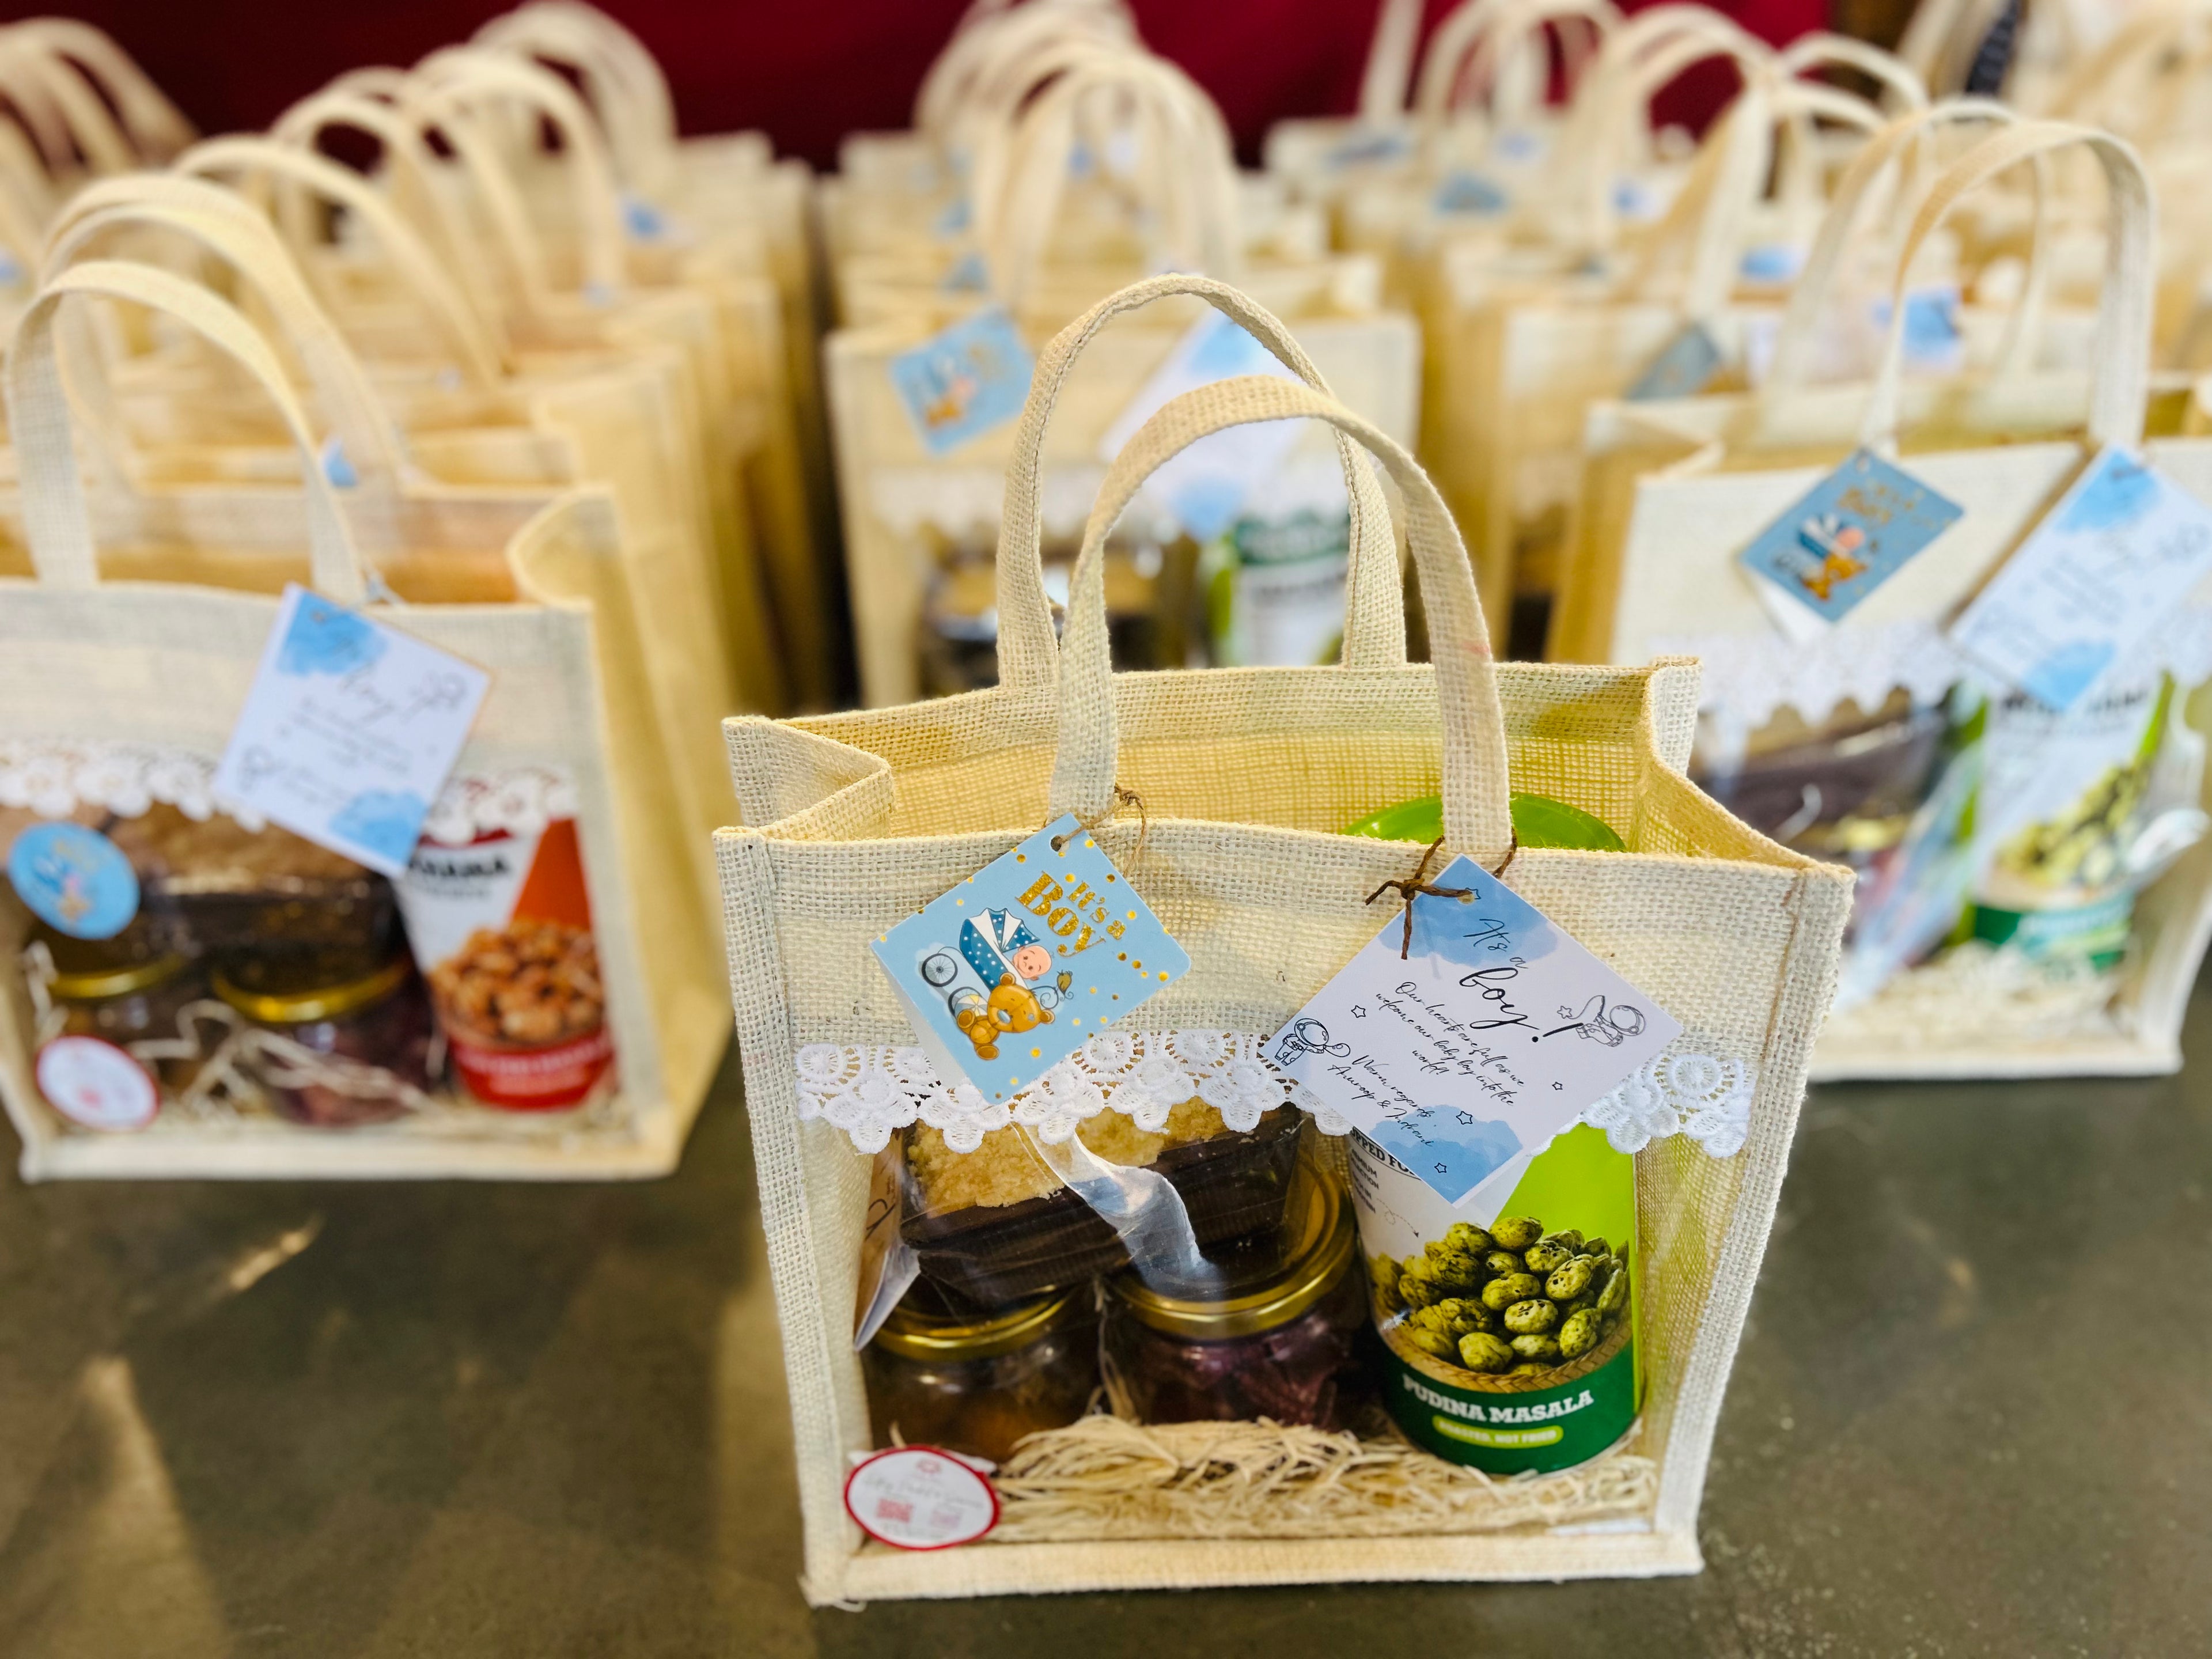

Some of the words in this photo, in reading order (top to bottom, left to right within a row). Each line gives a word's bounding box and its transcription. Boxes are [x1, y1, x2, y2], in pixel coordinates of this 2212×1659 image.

[1067, 880, 1110, 923] It's
[1107, 920, 1126, 940] a
[1509, 957, 1528, 969] a
[1459, 967, 1584, 1043] boy!
[1376, 993, 1415, 1025] welcome
[1414, 1025, 1434, 1040] our
[1433, 1040, 1459, 1061] baby
[1457, 1059, 1476, 1075] boy
[1476, 1075, 1504, 1091] into
[1490, 1090, 1518, 1107] the
[1395, 982, 1425, 1005] Our
[1425, 1004, 1465, 1032] hearts
[1458, 1032, 1478, 1047] are
[1468, 1047, 1508, 1067] full
[1495, 1063, 1510, 1075] as
[1510, 1074, 1524, 1086] we
[1327, 1064, 1377, 1100] Anuroop
[1377, 1100, 1391, 1109] &
[1351, 1055, 1391, 1087] Warm
[1412, 1050, 1450, 1075] world!
[1402, 1373, 1487, 1422] PUDINA
[1488, 1389, 1594, 1423] MASALA
